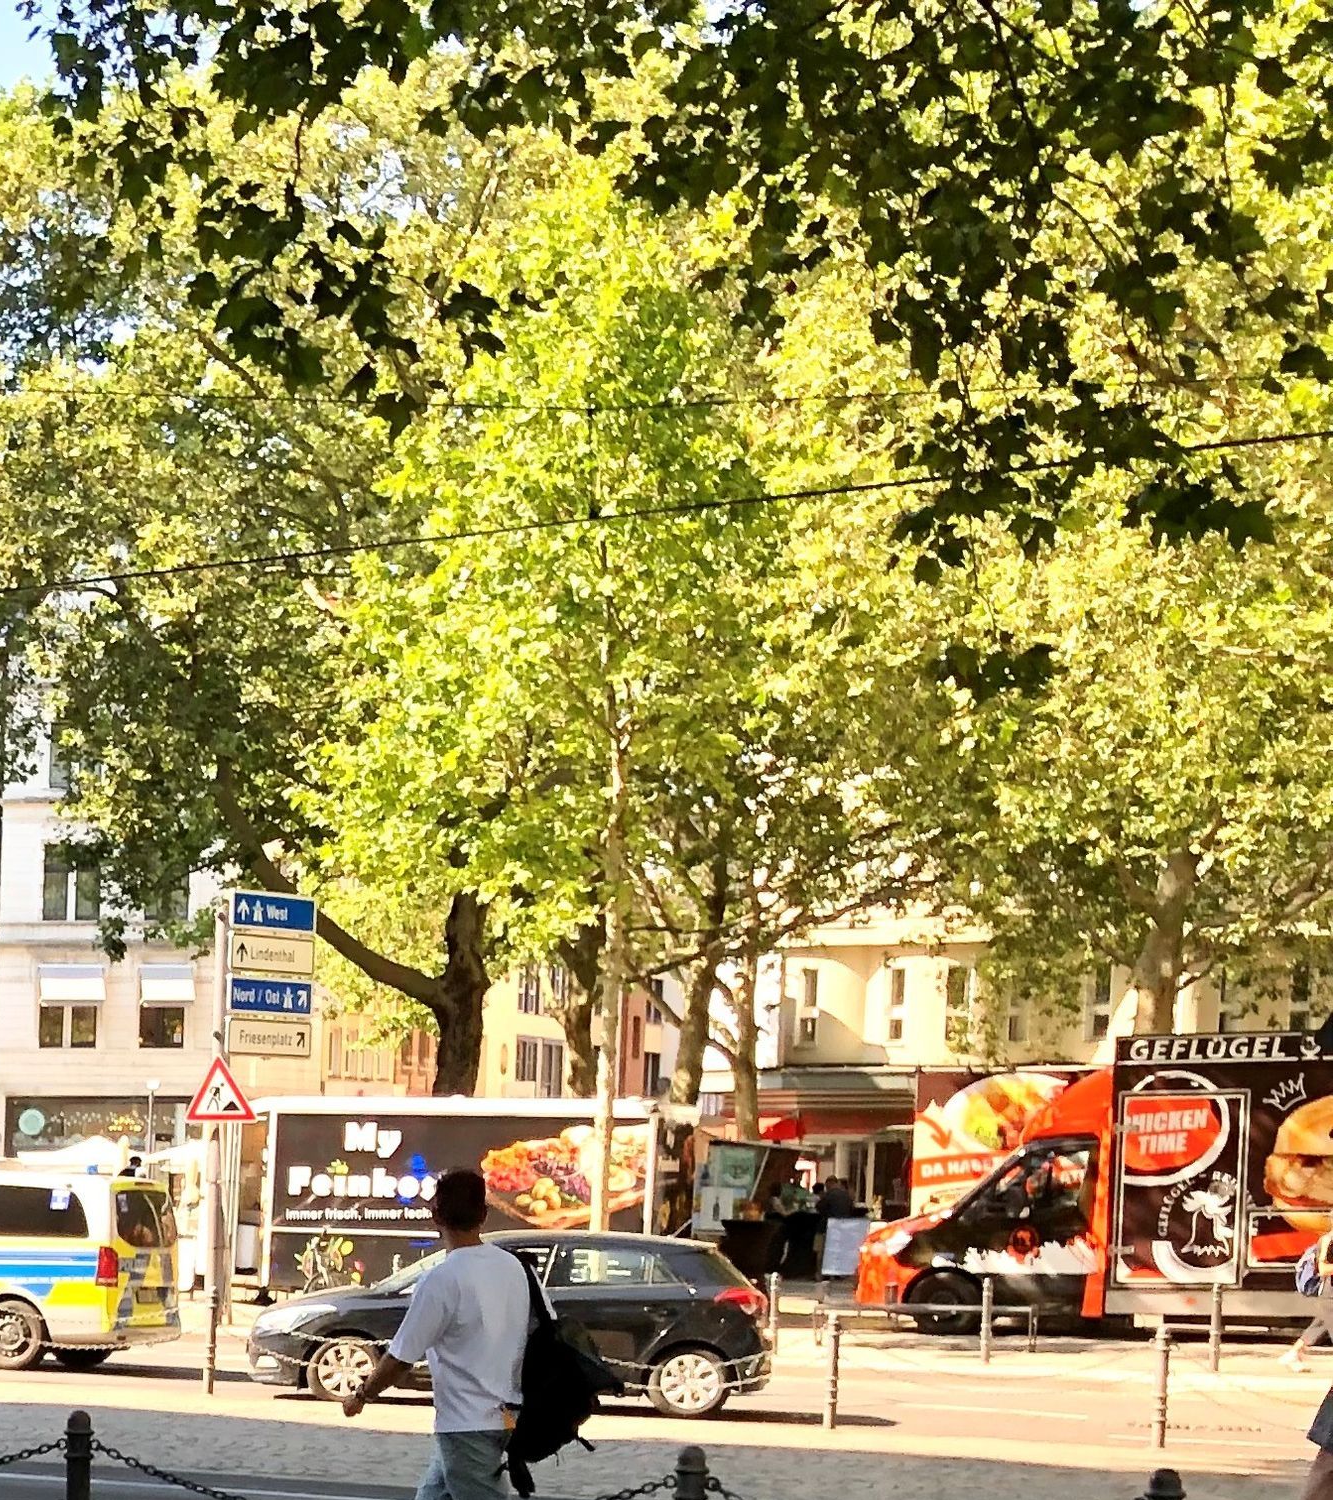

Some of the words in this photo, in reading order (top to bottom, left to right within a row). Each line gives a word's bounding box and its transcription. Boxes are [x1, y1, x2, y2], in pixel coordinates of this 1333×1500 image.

[266, 904, 288, 921] West
[250, 945, 295, 963] Lindenthal
[234, 986, 256, 1003] Nord
[265, 989, 280, 1005] Ost
[239, 1030, 293, 1049] Friesenplatz
[1129, 1036, 1285, 1061] GEFLÜGEL
[344, 1121, 402, 1158] My
[1138, 1132, 1187, 1155] TIME
[921, 1163, 944, 1178] DA
